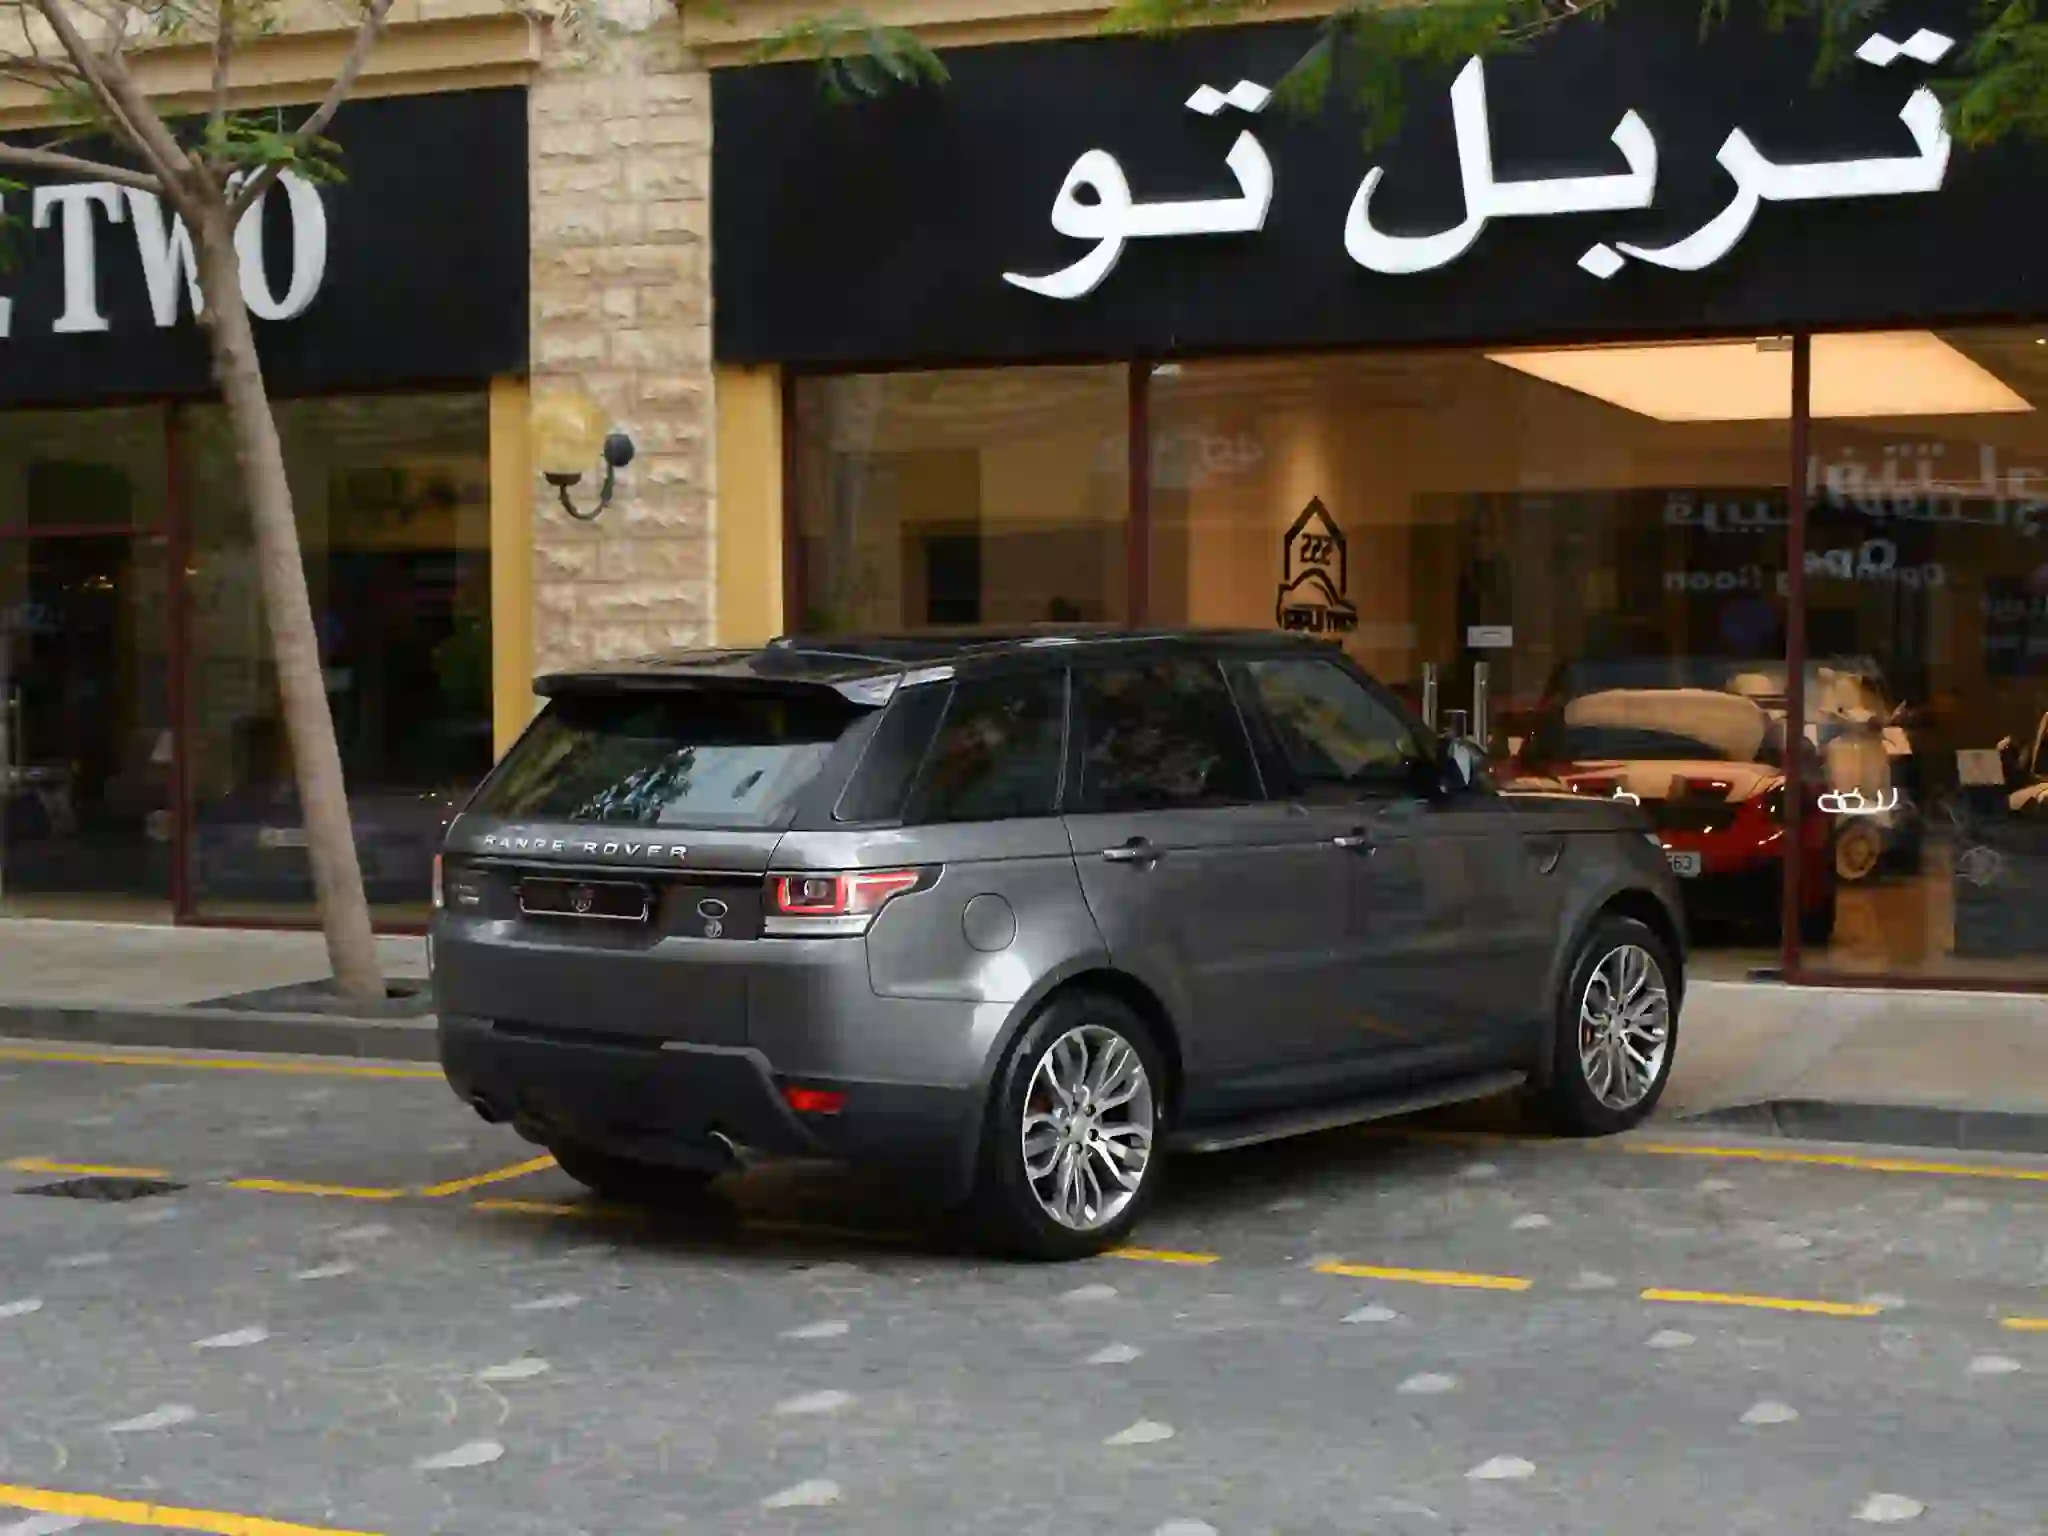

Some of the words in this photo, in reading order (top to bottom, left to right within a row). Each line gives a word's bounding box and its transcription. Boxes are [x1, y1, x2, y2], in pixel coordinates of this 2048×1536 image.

[32, 162, 328, 333] TWO
[1001, 79, 1274, 299] تو
[483, 833, 566, 853] RANGE
[582, 842, 688, 860] ROVER
